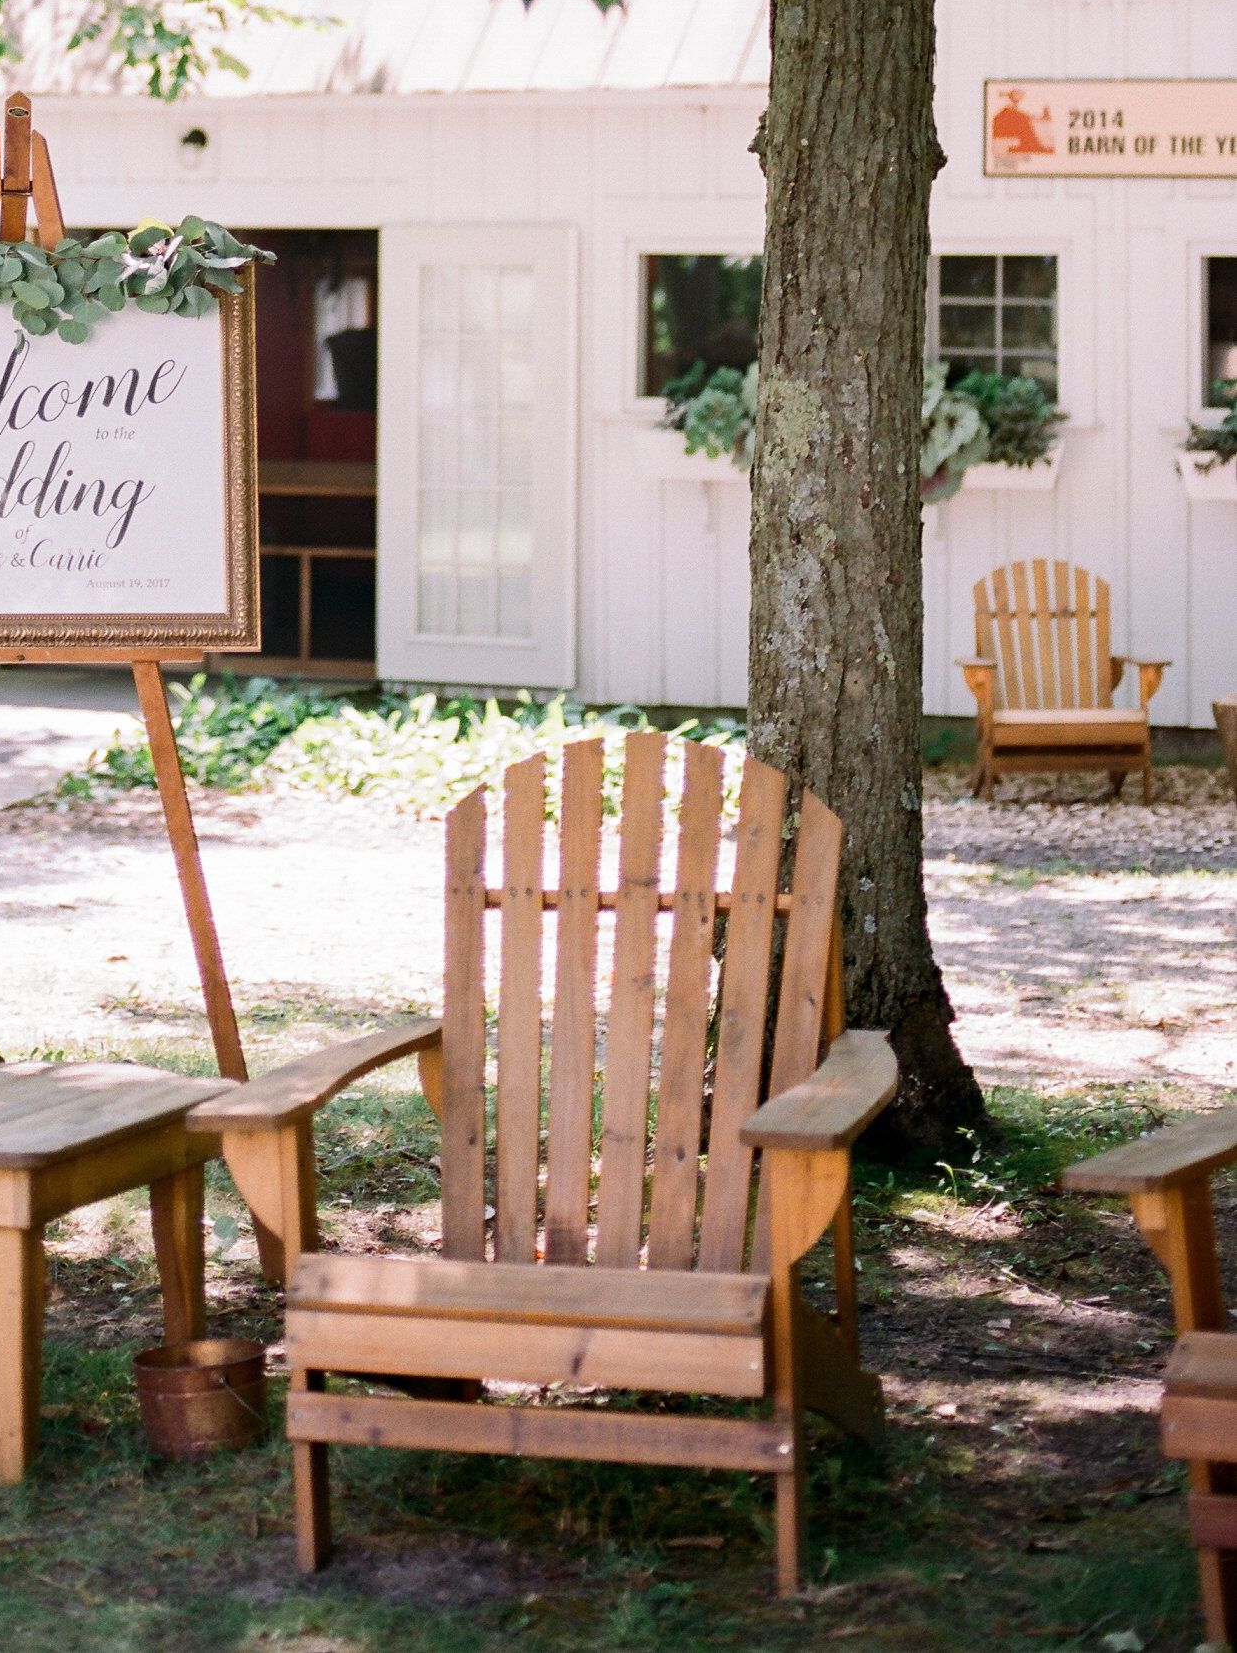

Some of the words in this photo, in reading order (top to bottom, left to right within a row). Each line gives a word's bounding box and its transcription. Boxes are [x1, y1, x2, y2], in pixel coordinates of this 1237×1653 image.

[1069, 109, 1124, 129] 2014
[1068, 136, 1125, 154] BARN
[1134, 136, 1157, 154] OF
[1169, 136, 1203, 154] THE
[95, 427, 110, 441] to
[114, 425, 136, 441] the
[14, 524, 33, 545] of
[11, 552, 25, 568] &
[29, 538, 110, 572] Carrie
[86, 578, 126, 590] August
[146, 578, 171, 589] 2017
